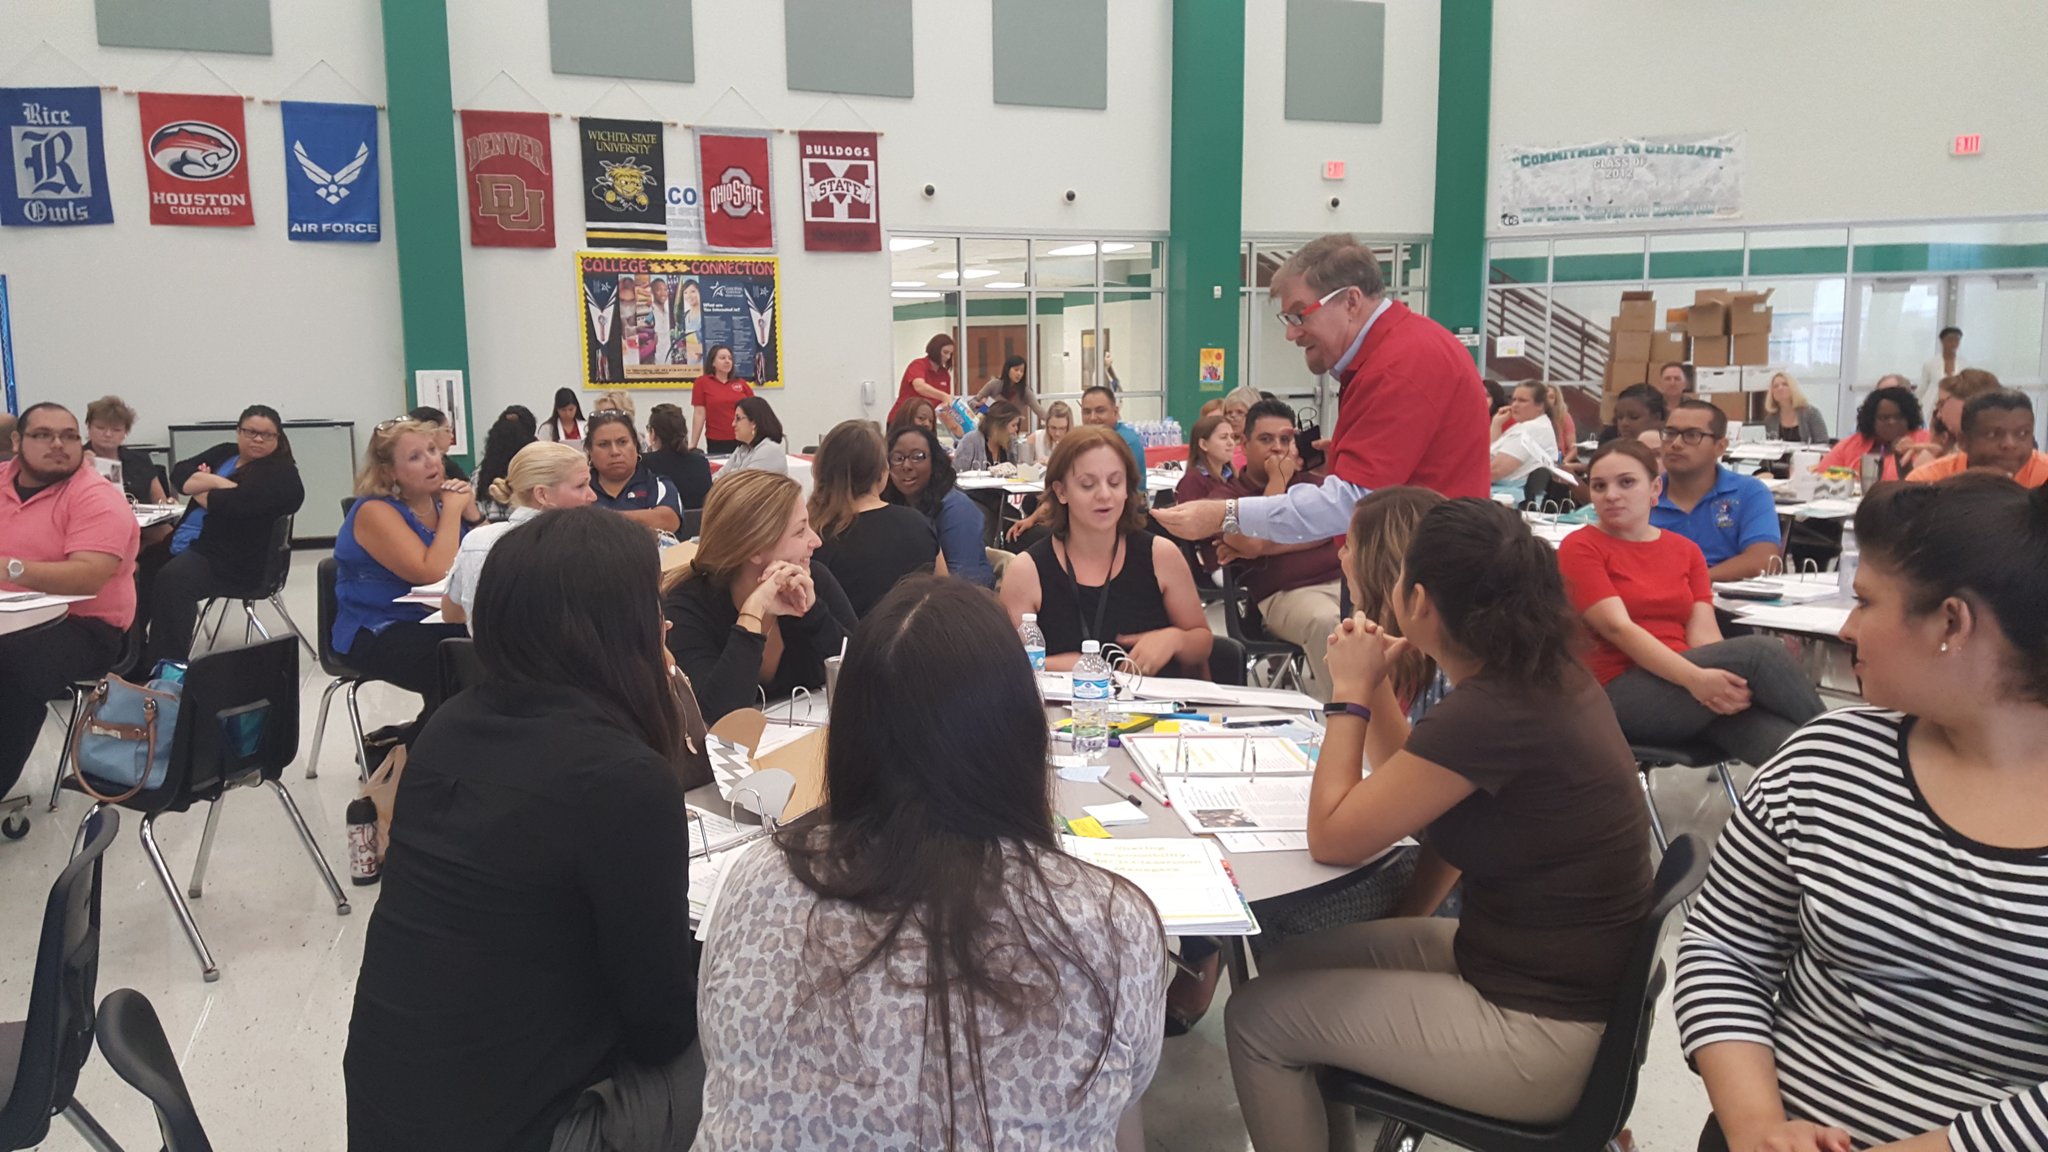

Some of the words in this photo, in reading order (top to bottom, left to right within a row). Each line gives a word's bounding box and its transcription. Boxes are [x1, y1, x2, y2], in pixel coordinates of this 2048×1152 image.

[22, 103, 71, 125] Rice
[588, 130, 630, 143] WICHITA
[631, 133, 657, 144] STATE
[467, 132, 545, 174] DENVER
[596, 141, 650, 155] UNIVERSITY
[805, 144, 870, 156] BULLDOGS
[21, 130, 83, 195] R
[1593, 156, 1630, 169] CLASS
[819, 179, 862, 199] STATE
[152, 192, 246, 206] HOUSTON
[24, 200, 88, 222] Owls
[170, 206, 230, 216] COUGARS
[291, 223, 318, 233] AIR
[321, 223, 378, 233] FORCE
[583, 258, 648, 273] COLLEGE
[691, 262, 774, 276] CONNECTION
